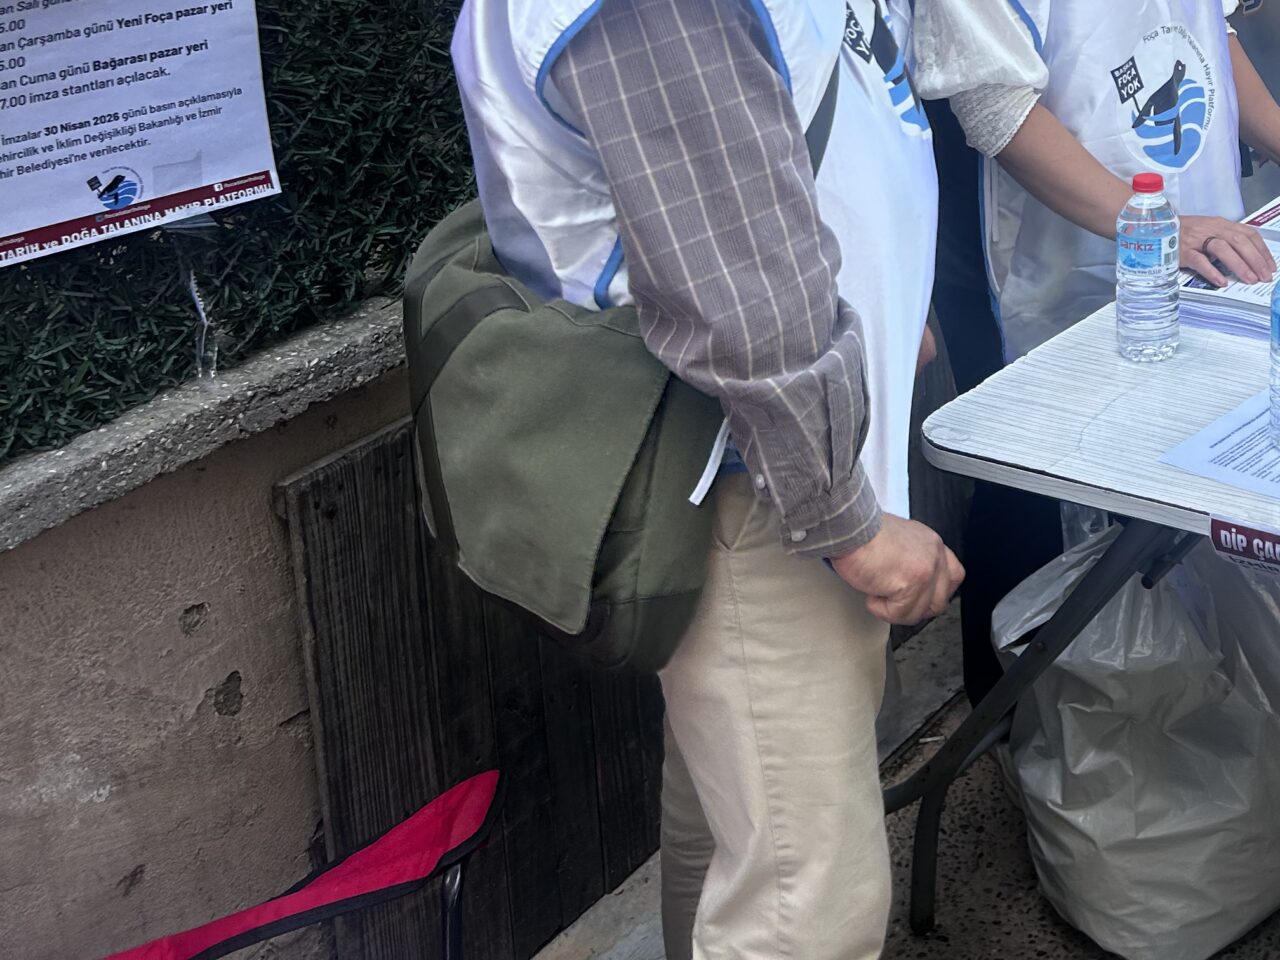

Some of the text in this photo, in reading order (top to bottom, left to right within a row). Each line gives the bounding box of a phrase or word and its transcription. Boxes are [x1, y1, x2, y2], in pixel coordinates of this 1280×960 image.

[17, 26, 82, 52] Çarşamba
[83, 18, 115, 39] günü
[116, 11, 143, 29] Yeni
[144, 8, 174, 28] Foça
[175, 5, 208, 24] pazar
[1142, 30, 1159, 44] Foça
[19, 72, 56, 88] Cuma
[59, 62, 91, 82] günü
[92, 51, 149, 73] Bağarası
[149, 45, 184, 64] pazar
[185, 39, 209, 58] yeri
[1118, 68, 1137, 88] FOÇA
[29, 89, 60, 105] imza
[61, 77, 115, 98] stantları
[116, 66, 171, 88] açılacak.
[1121, 79, 1141, 100] YOK
[41, 141, 55, 153] ve
[56, 130, 83, 150] İklim
[83, 121, 137, 145] Değişikliği
[138, 113, 185, 135] Bakanlığı
[185, 110, 198, 122] ve
[198, 103, 223, 120] İzmir
[43, 124, 59, 137] 30
[60, 118, 91, 135] Nisan
[92, 112, 121, 128] 2026
[122, 105, 149, 123] günü
[149, 100, 177, 116] basın
[178, 85, 243, 110] açıklamasıyla
[16, 151, 88, 177] Belediyesi'ne
[89, 138, 152, 159] verilecektir.
[0, 242, 40, 262] TARİH
[42, 239, 59, 251] ve
[60, 225, 99, 248] DOĞA
[100, 210, 162, 236] TALANINA
[203, 181, 275, 208] PLATFORMU
[1219, 527, 1247, 553] DİP
